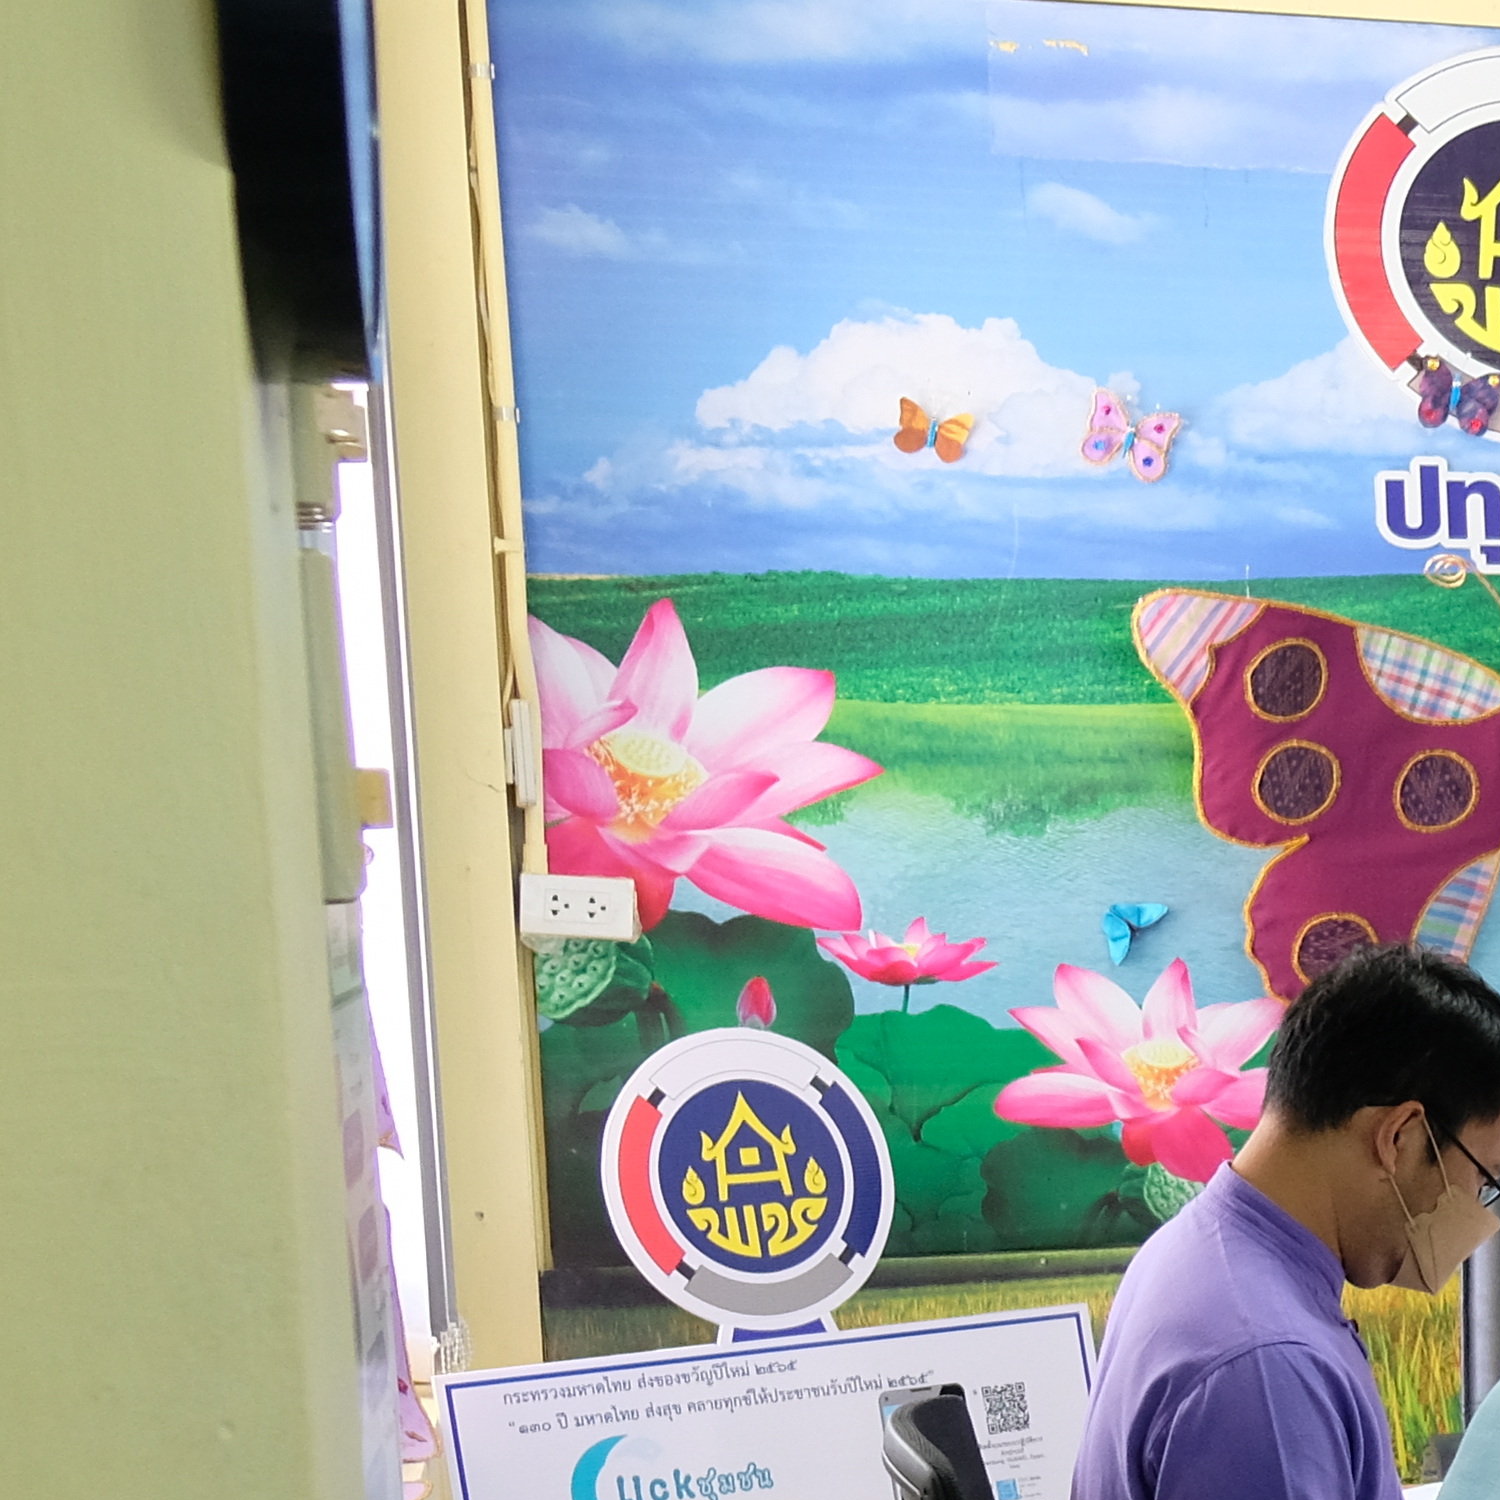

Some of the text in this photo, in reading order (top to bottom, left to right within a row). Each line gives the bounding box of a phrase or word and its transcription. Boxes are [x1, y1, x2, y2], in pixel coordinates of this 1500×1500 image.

[503, 1358, 798, 1406] กระทรวงมหาดไทย ส่งของขวัญปีใหม่ ๒๕๖๕
[556, 1412, 569, 1430] ปี
[574, 1405, 640, 1428] มหาดไทย
[645, 1401, 682, 1423] ส่งสุข
